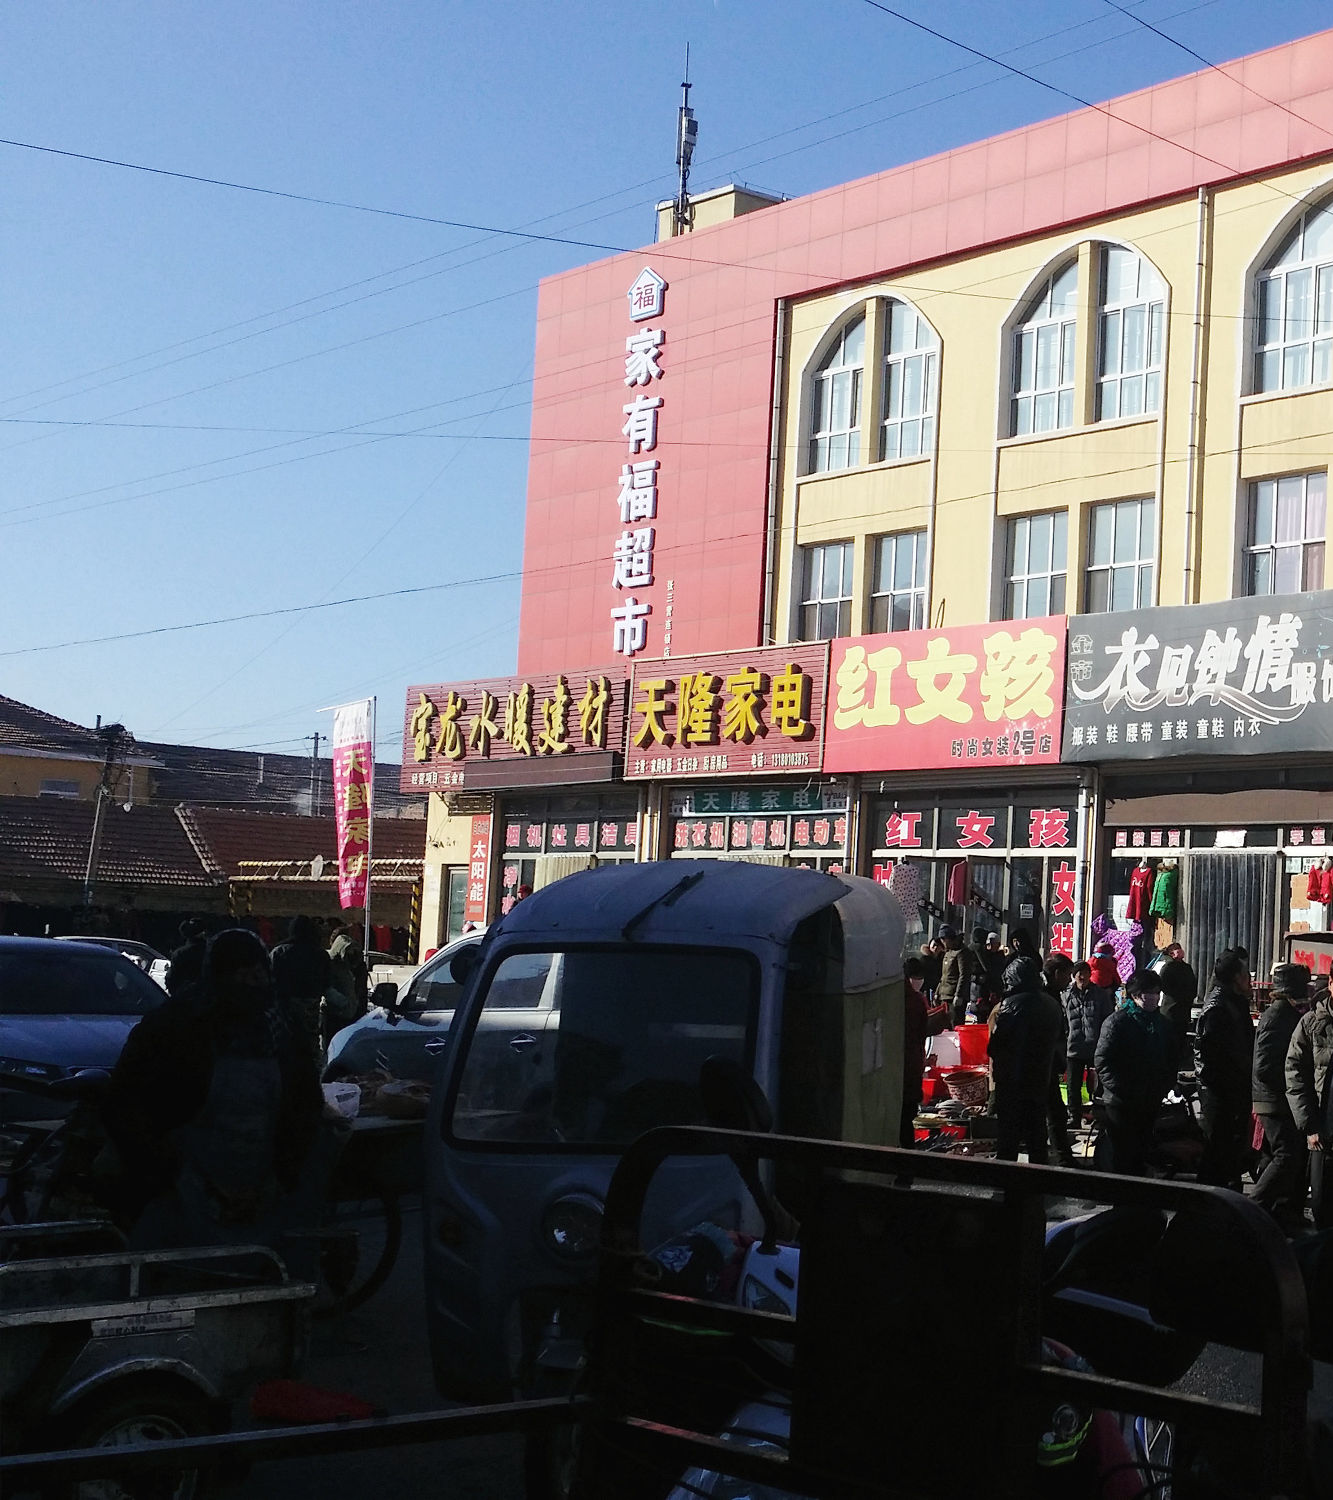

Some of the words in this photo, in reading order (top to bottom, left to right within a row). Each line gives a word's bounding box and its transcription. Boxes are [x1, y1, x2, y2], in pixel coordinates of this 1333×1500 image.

[633, 284, 654, 309] 福
[610, 328, 665, 656] 家有福超市
[834, 628, 1057, 730] 红女孩
[633, 663, 807, 747] 天隆家电
[952, 730, 1052, 758] 时尚女装2号店
[1072, 725, 1098, 745] 服装
[1106, 724, 1118, 743] 鞋
[1126, 722, 1153, 743] 腰带
[1161, 720, 1188, 741] 童装
[1197, 718, 1224, 739] 童鞋
[1234, 716, 1261, 736] 内衣
[702, 789, 812, 811] 天隆家电
[506, 825, 541, 847] 烟机
[551, 824, 590, 846] 灶具
[601, 823, 638, 846] 洁具
[675, 820, 724, 848] 洗衣机
[731, 820, 785, 847] 油烟机
[794, 816, 846, 846] 电动车
[885, 808, 1070, 848] 红女孩
[1116, 830, 1180, 847] 日杂百货
[470, 841, 486, 901] 太阳能
